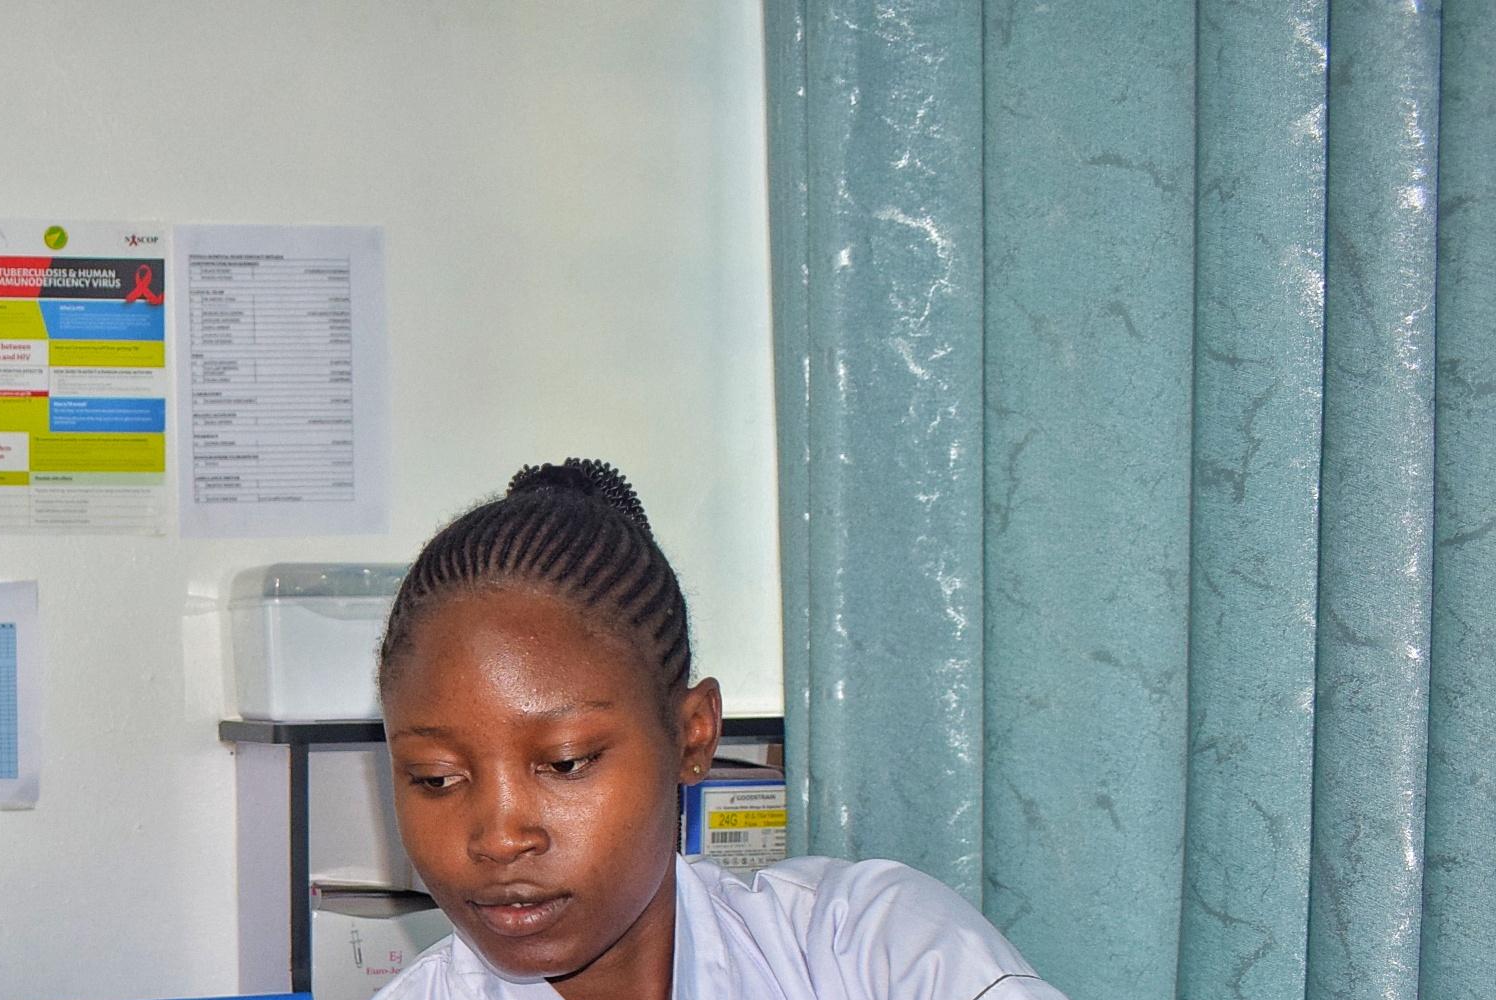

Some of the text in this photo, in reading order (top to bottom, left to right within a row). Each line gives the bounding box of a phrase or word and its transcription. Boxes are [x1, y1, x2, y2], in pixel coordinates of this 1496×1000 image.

[68, 269, 78, 278] &
[78, 269, 116, 279] HUMAN
[92, 278, 122, 288] VIRUS
[1, 342, 31, 350] between
[3, 353, 15, 361] and
[16, 353, 31, 361] HIV
[718, 813, 738, 827] 24G
